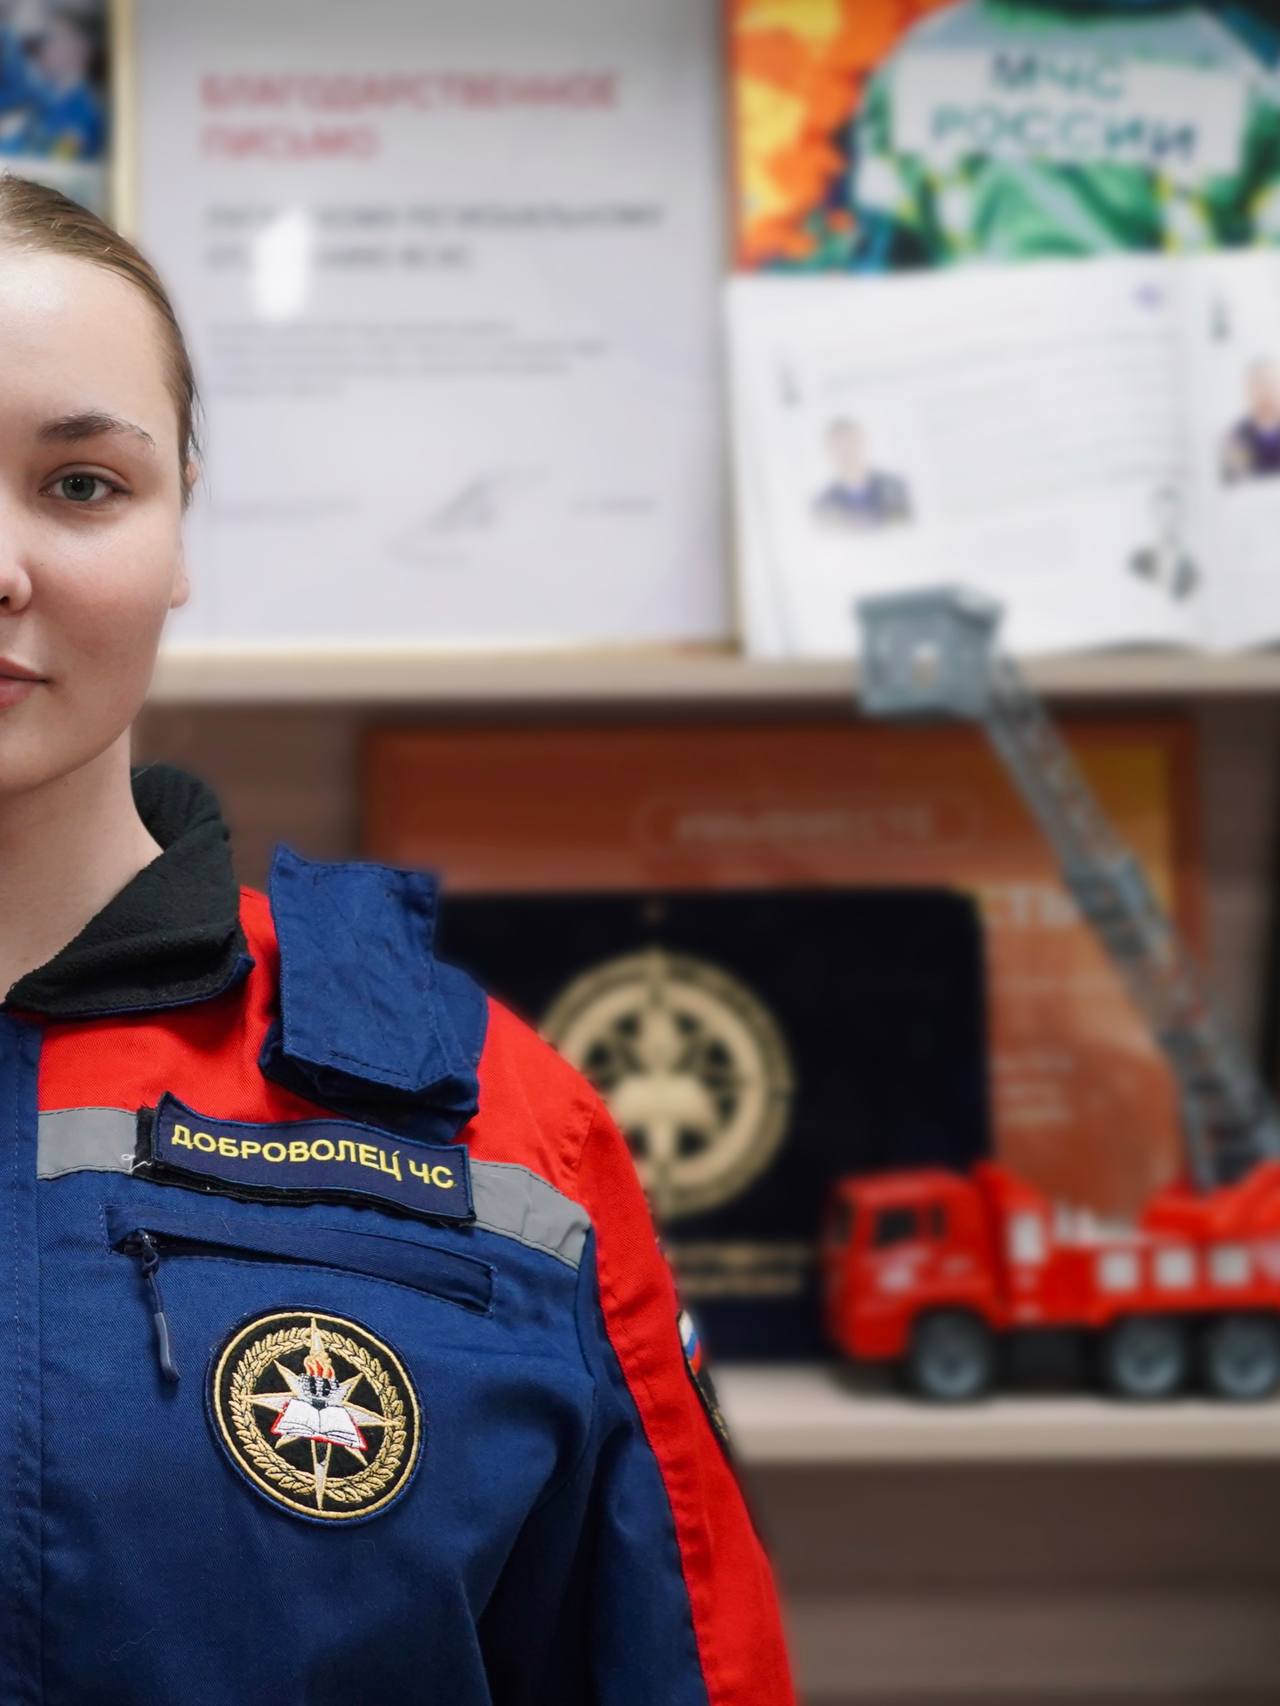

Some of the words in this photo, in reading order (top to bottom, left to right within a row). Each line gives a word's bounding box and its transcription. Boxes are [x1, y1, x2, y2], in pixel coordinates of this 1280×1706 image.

[993, 52, 1124, 100] МЧС
[931, 105, 1196, 159] РОССИИ
[171, 1124, 403, 1181] ДОБРОВОЛЕЦ
[409, 1159, 455, 1189] ЧС
